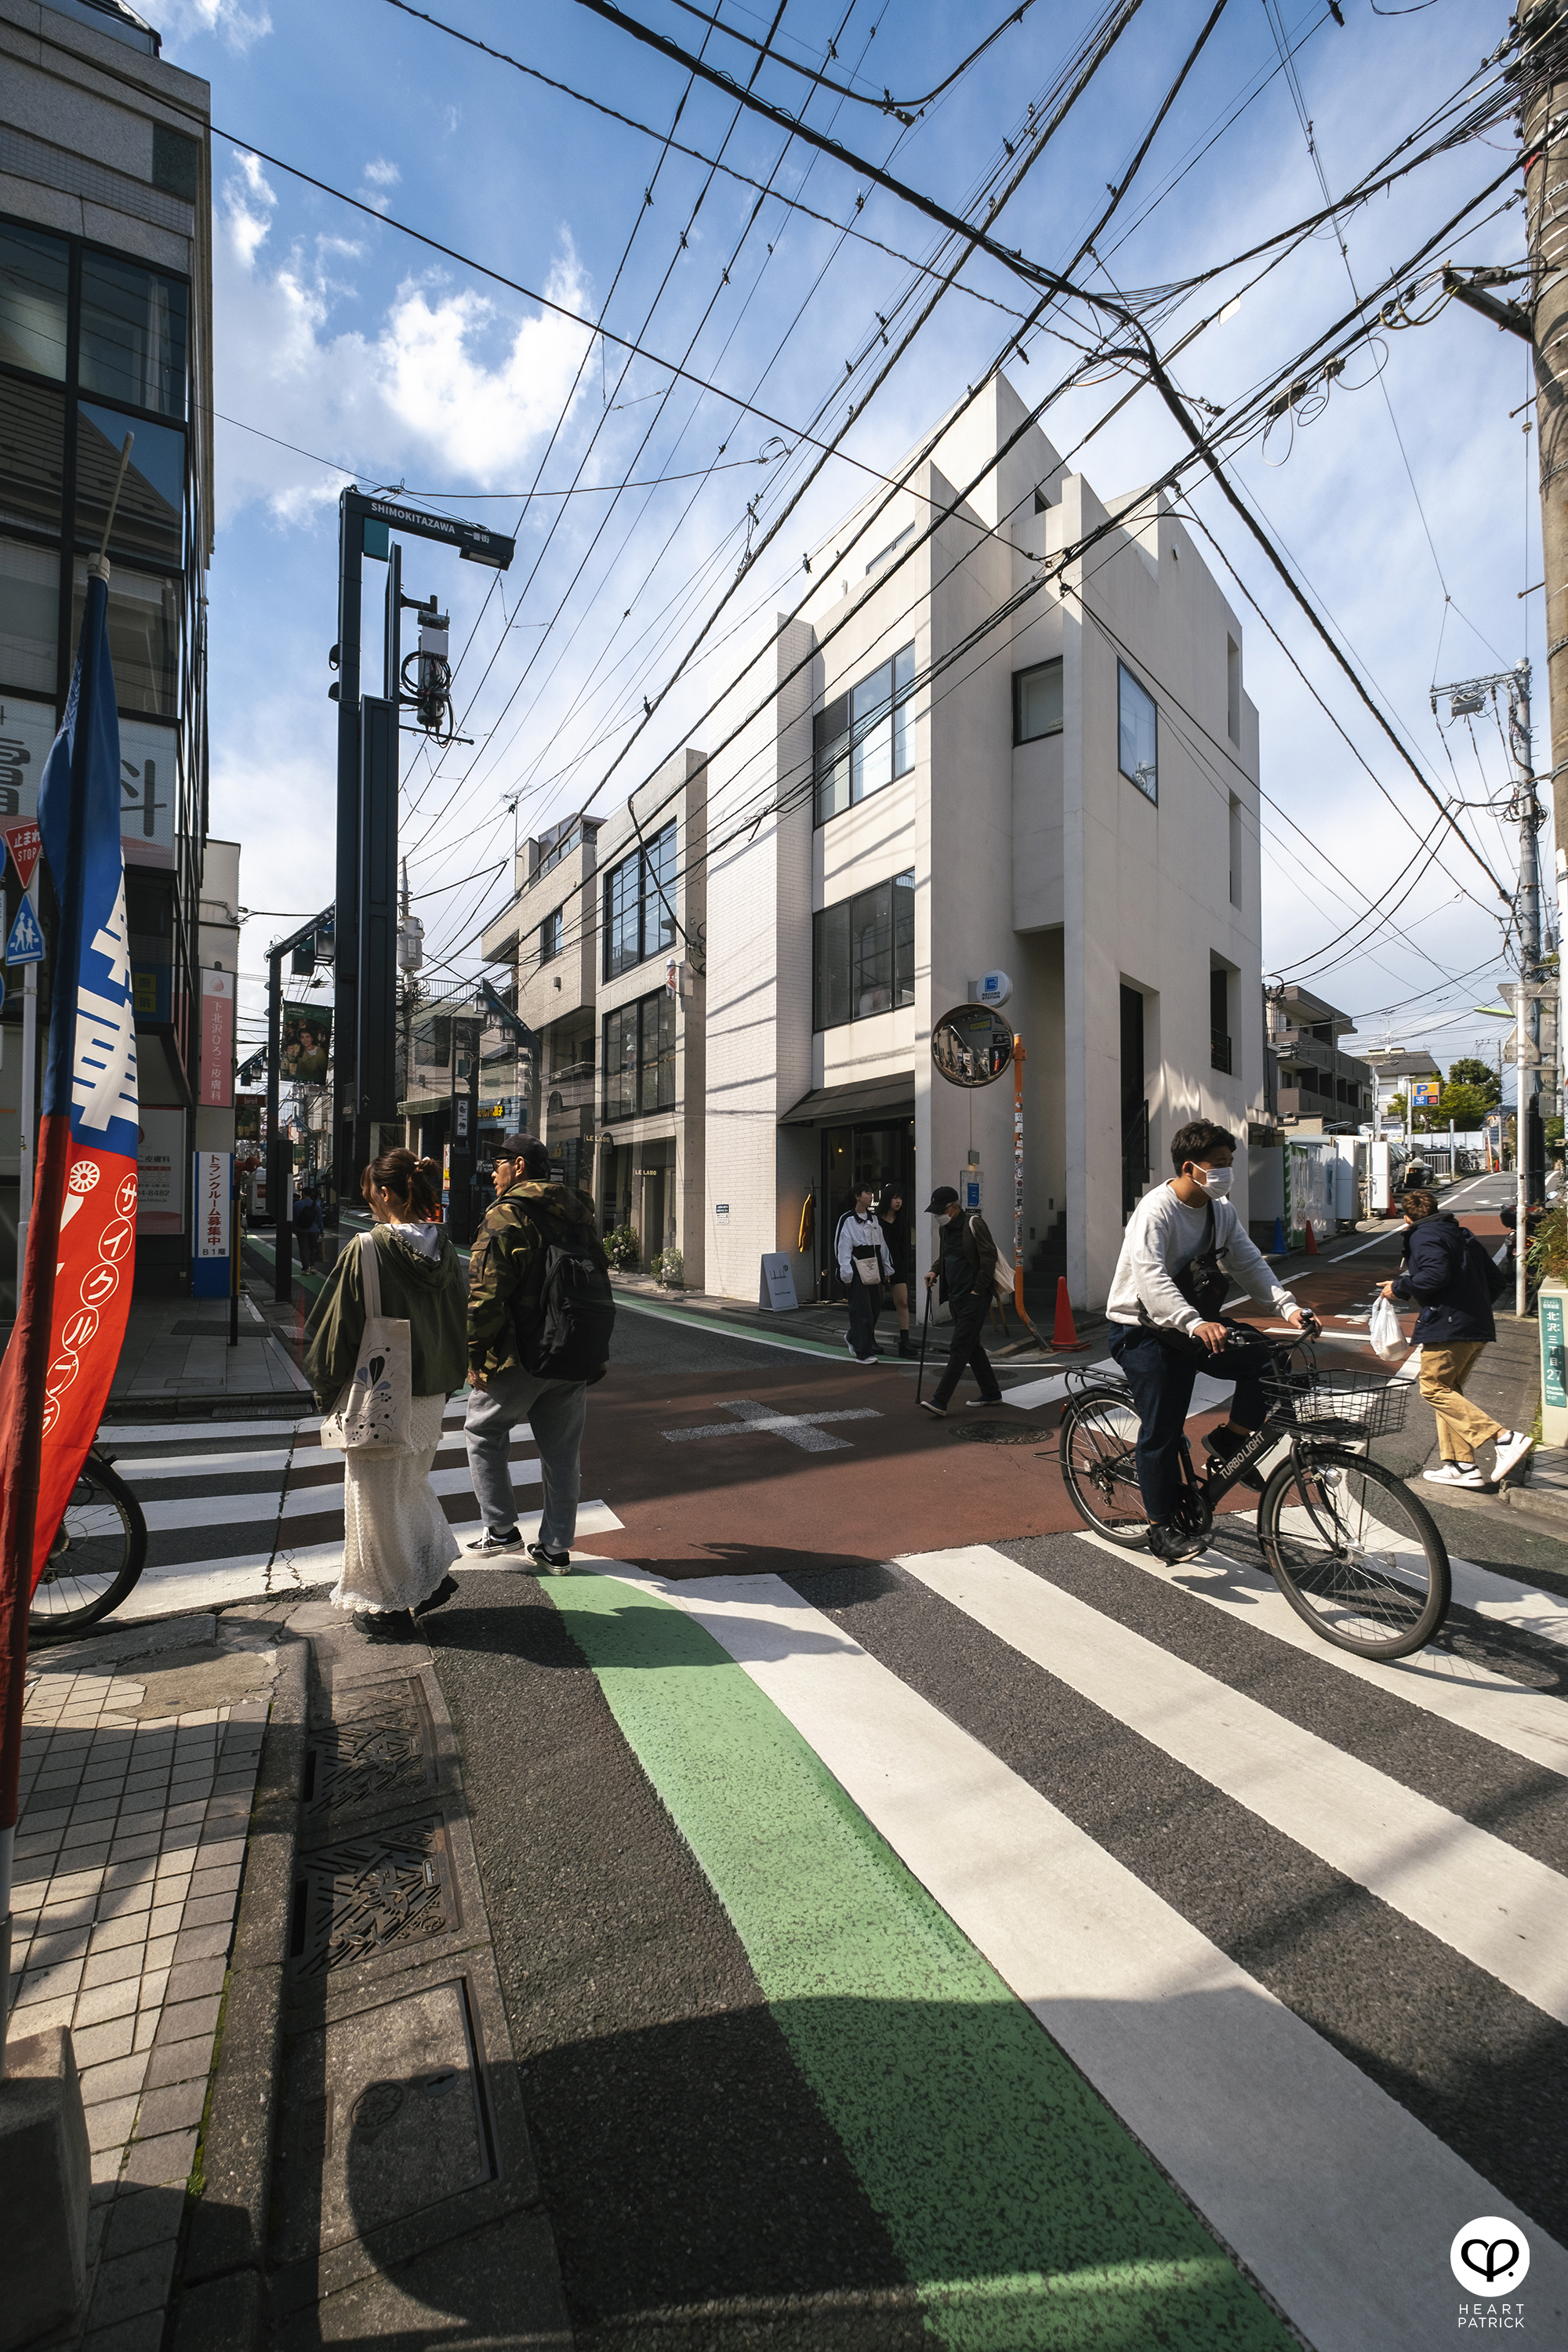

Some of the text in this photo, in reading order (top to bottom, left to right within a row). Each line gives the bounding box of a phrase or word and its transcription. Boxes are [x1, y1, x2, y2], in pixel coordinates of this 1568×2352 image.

[371, 503, 456, 535] SHIMOKITAZAWA
[463, 531, 490, 544] 一番街
[13, 829, 40, 848] 止まれ
[17, 847, 37, 862] STOP
[210, 1000, 223, 1101] 下北沢ひろこ皮膚科
[1417, 1085, 1428, 1094] P
[207, 1154, 222, 1246] トランクルーム募集中
[202, 1247, 226, 1256] B1階
[1546, 1311, 1559, 1367] 北沢三丁目
[1546, 1368, 1562, 1381] 27
[1219, 1431, 1265, 1479] TURBO LIGHT
